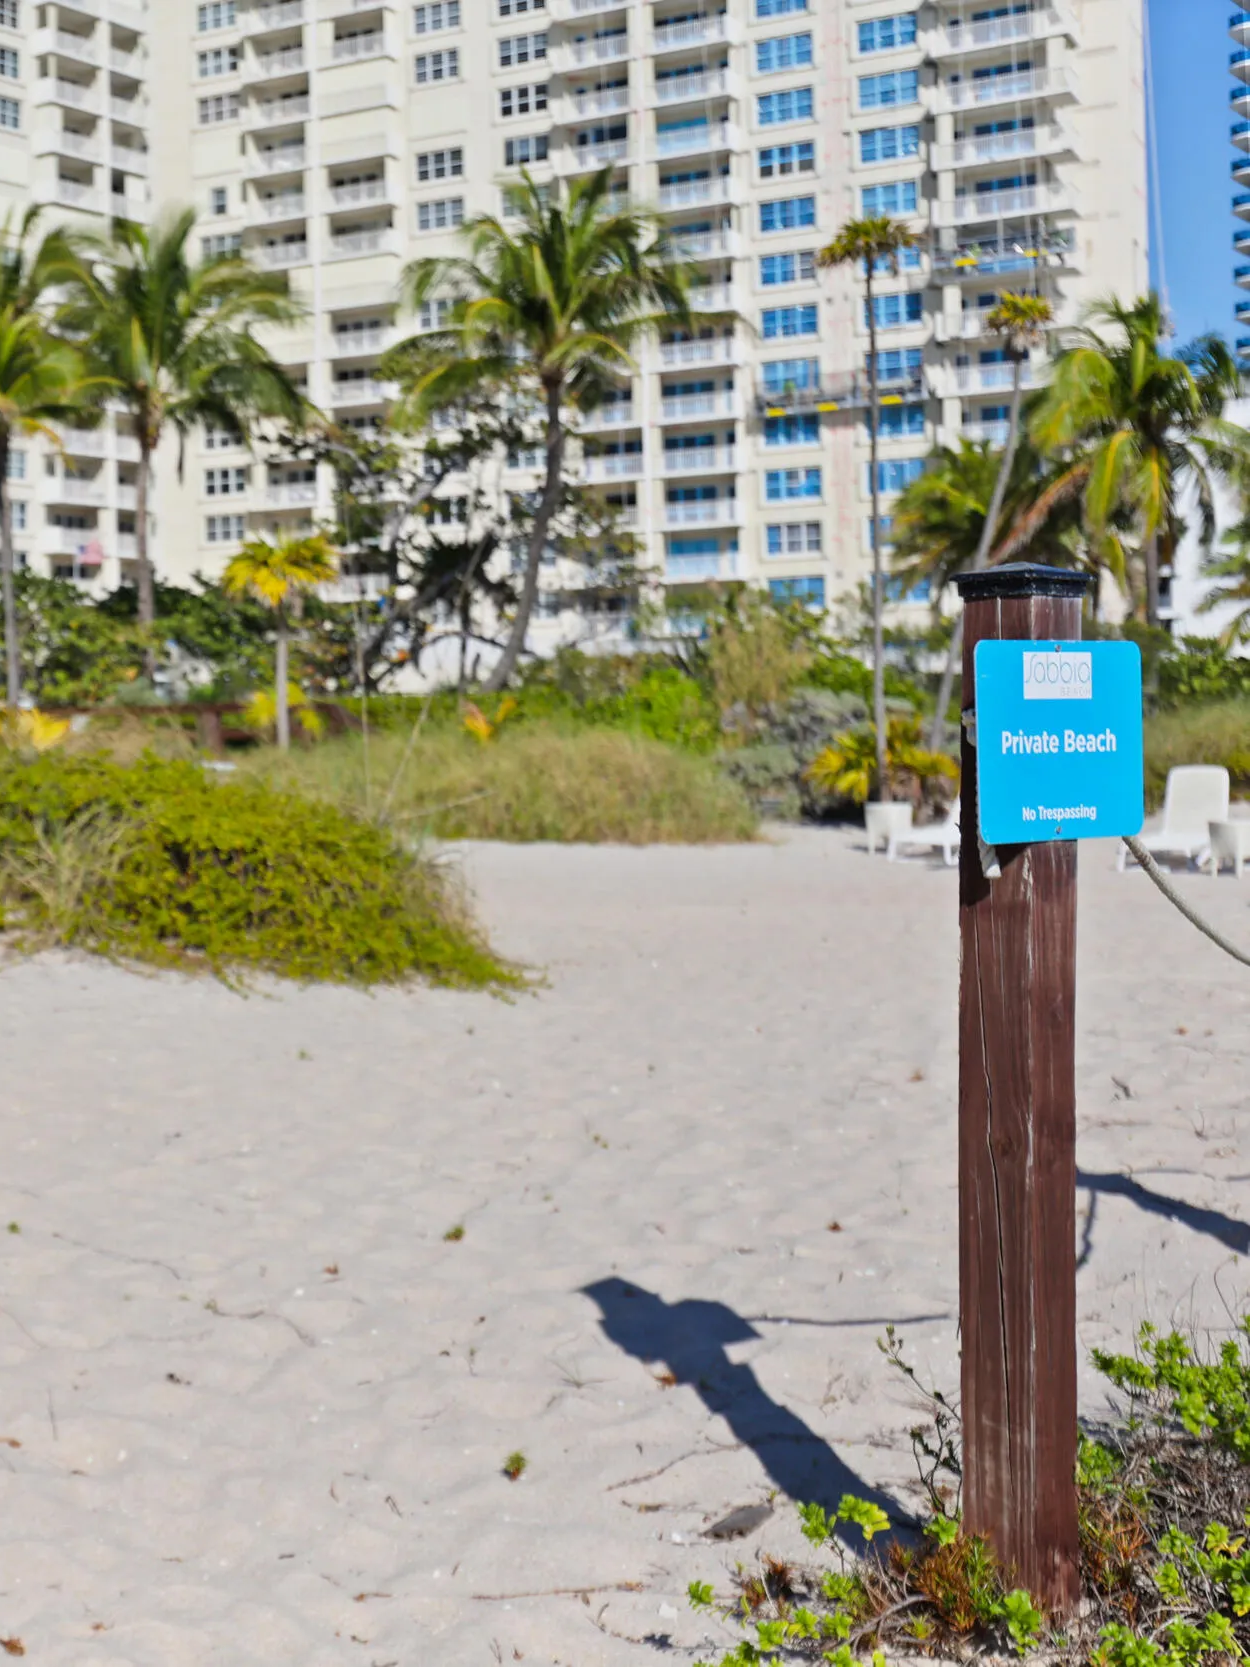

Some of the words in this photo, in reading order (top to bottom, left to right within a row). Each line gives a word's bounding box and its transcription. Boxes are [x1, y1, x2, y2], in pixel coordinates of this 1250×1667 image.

[1025, 653, 1091, 684] Sabbia
[1001, 729, 1060, 755] Private
[1063, 728, 1117, 753] Beach
[1022, 806, 1036, 821] No
[1038, 803, 1097, 822] Trespassing
